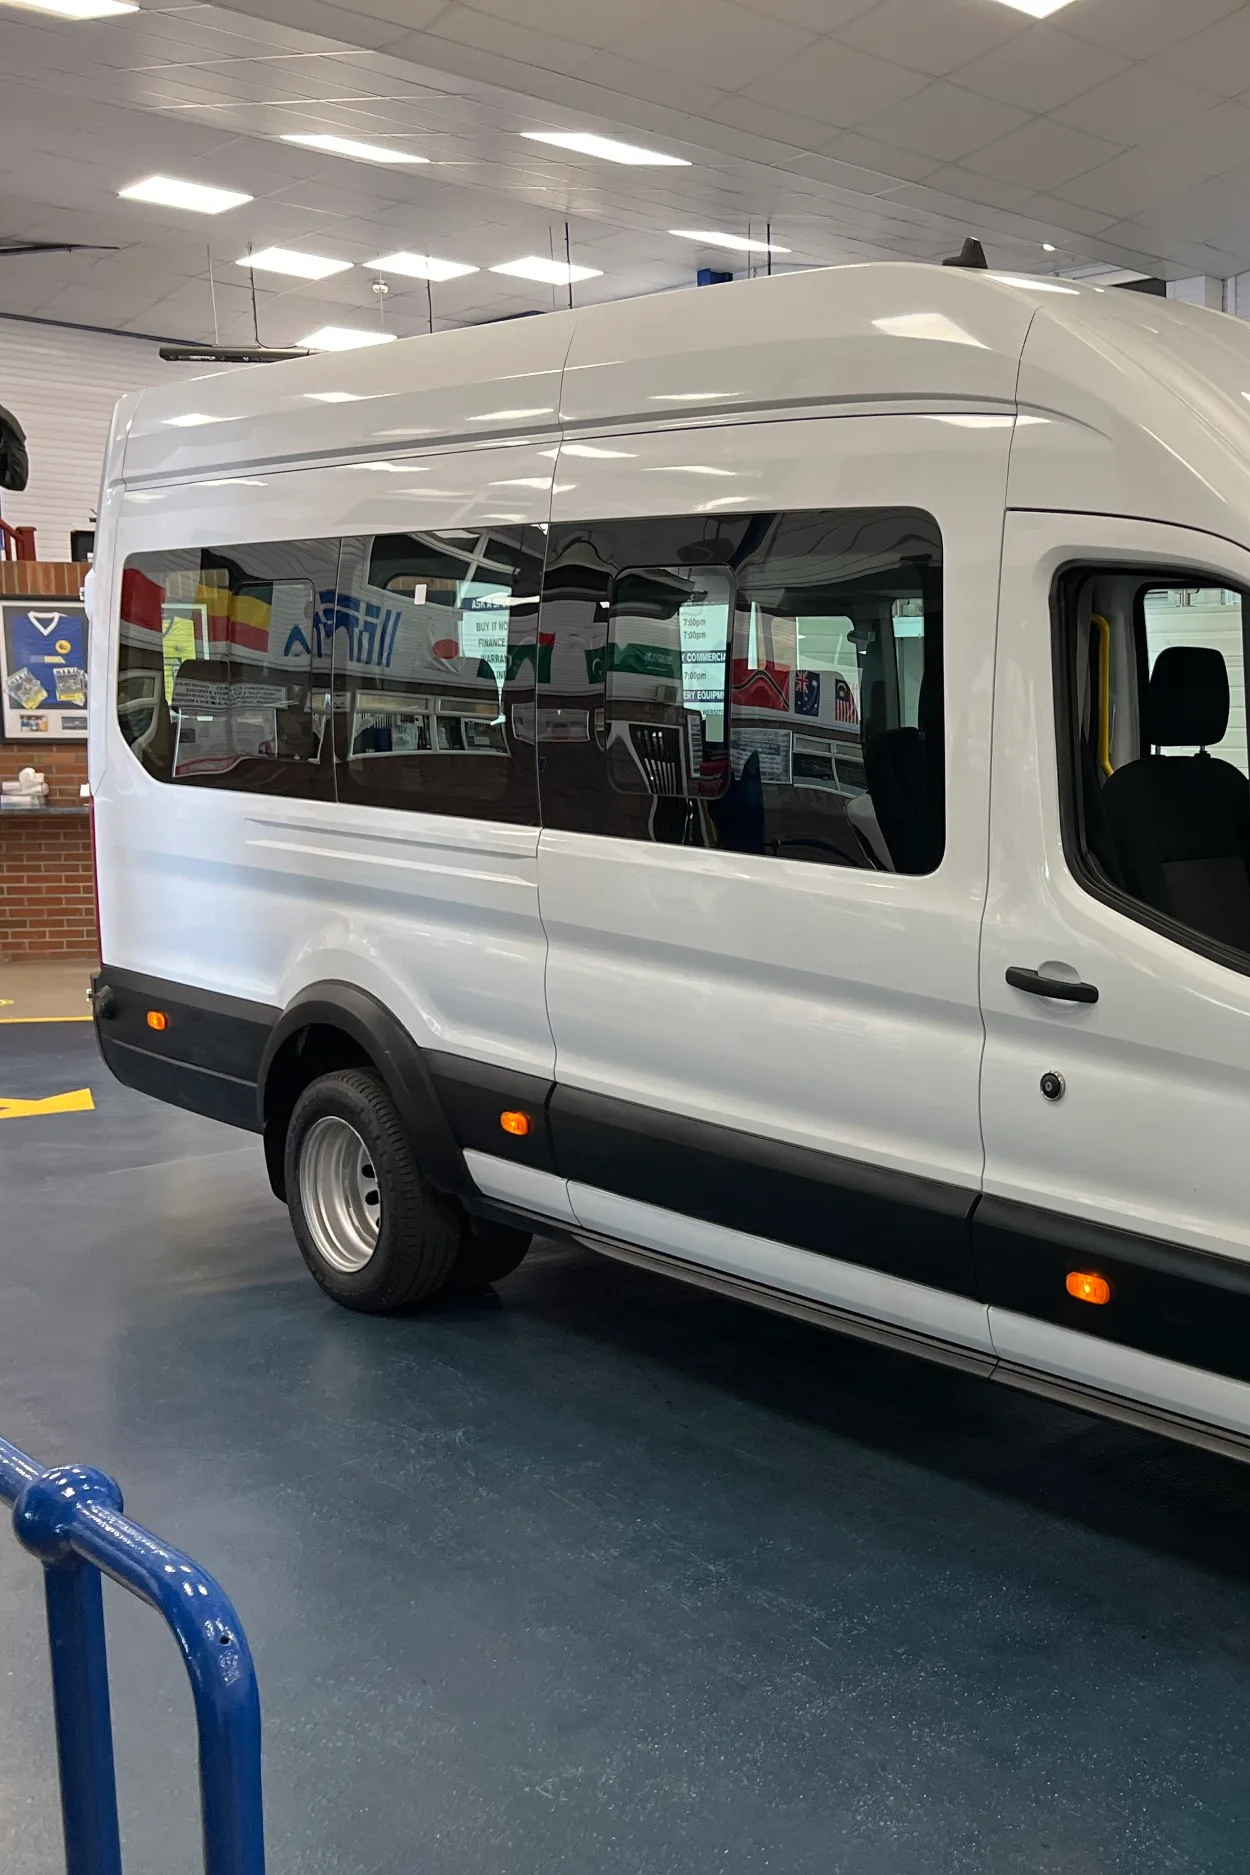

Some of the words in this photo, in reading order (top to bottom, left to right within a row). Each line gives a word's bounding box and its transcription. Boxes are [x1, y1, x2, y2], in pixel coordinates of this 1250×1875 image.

[476, 622, 490, 632] BUY
[491, 621, 498, 631] IT
[683, 618, 706, 628] 7:00pm
[683, 630, 706, 640] 7:00pm
[478, 637, 506, 648] FINANCE
[684, 671, 707, 681] 7:00pm
